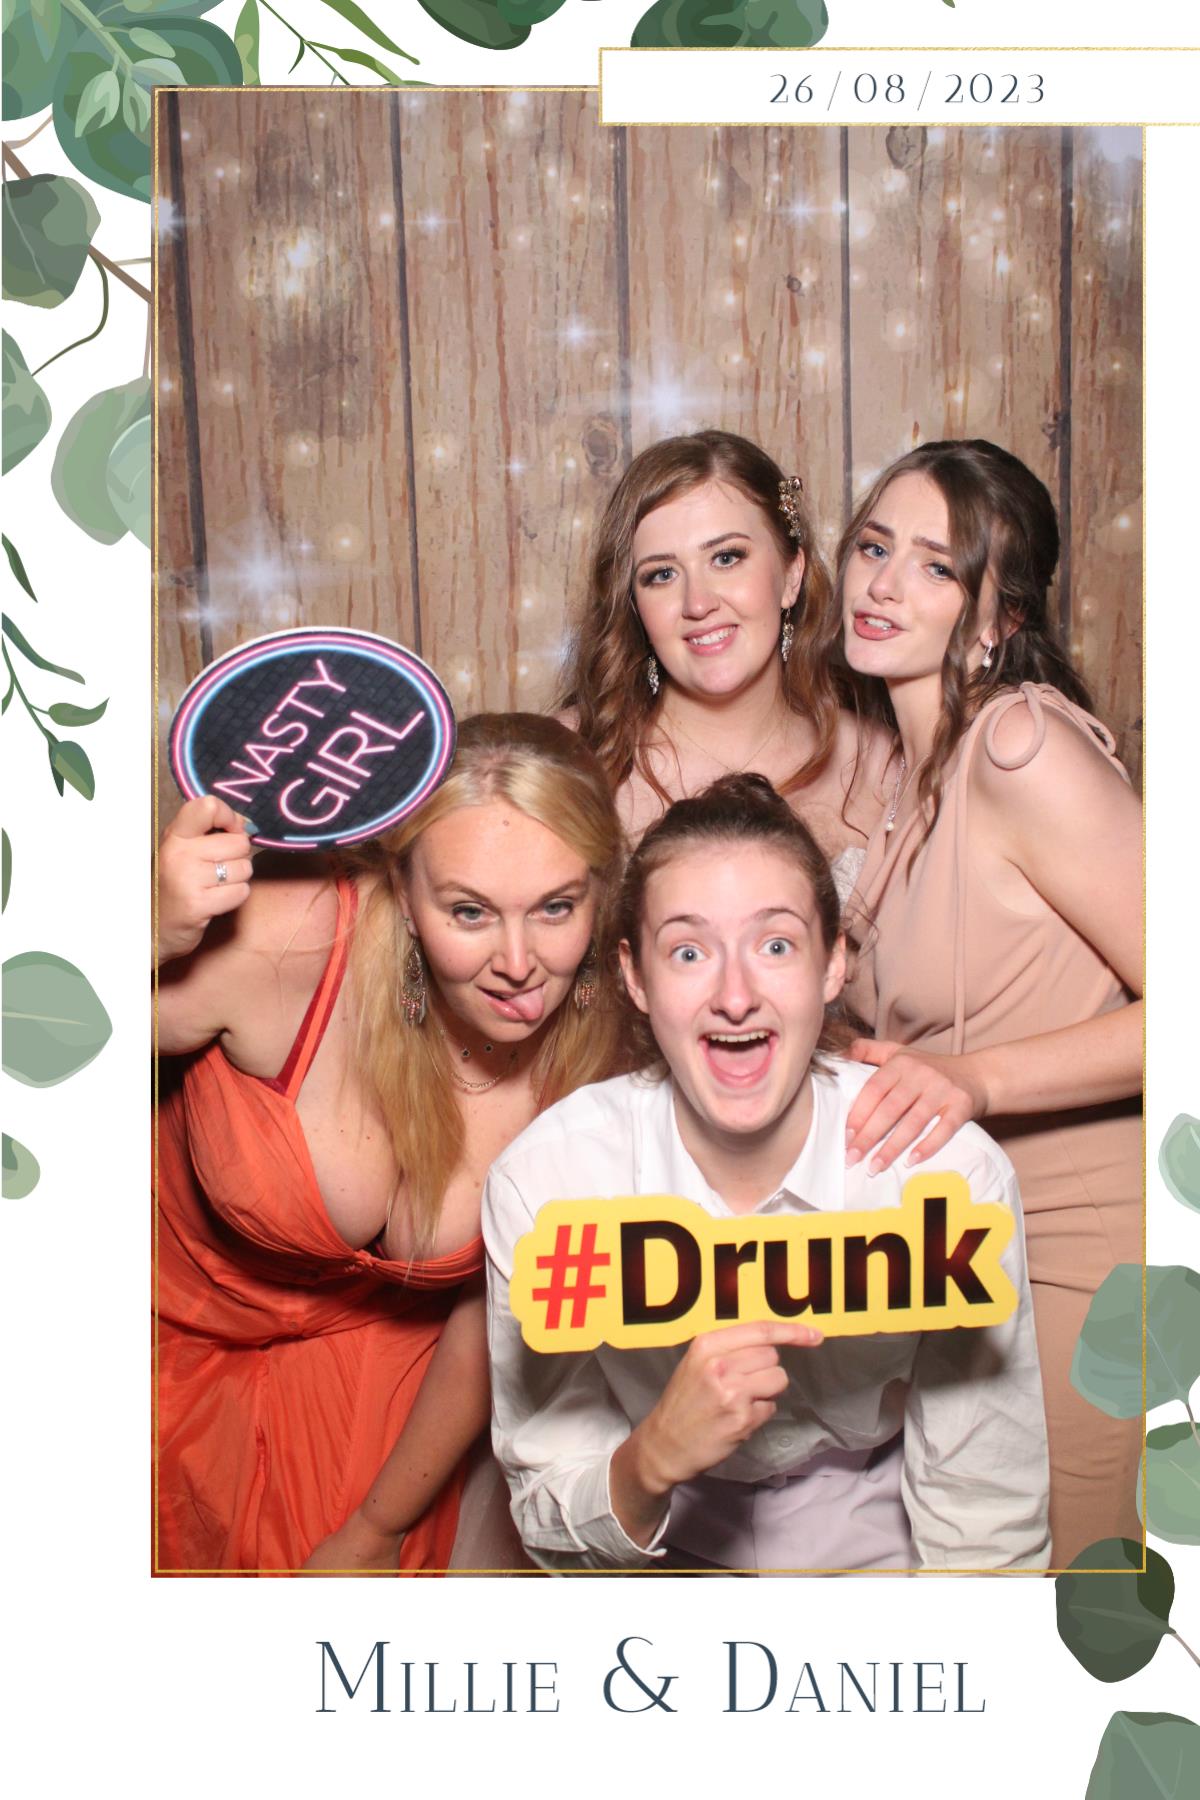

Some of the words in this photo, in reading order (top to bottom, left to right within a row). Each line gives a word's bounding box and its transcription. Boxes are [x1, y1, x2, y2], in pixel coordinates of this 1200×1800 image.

[213, 658, 347, 803] NASTY
[278, 710, 426, 827] GIRL
[531, 1196, 995, 1331] #Drunk
